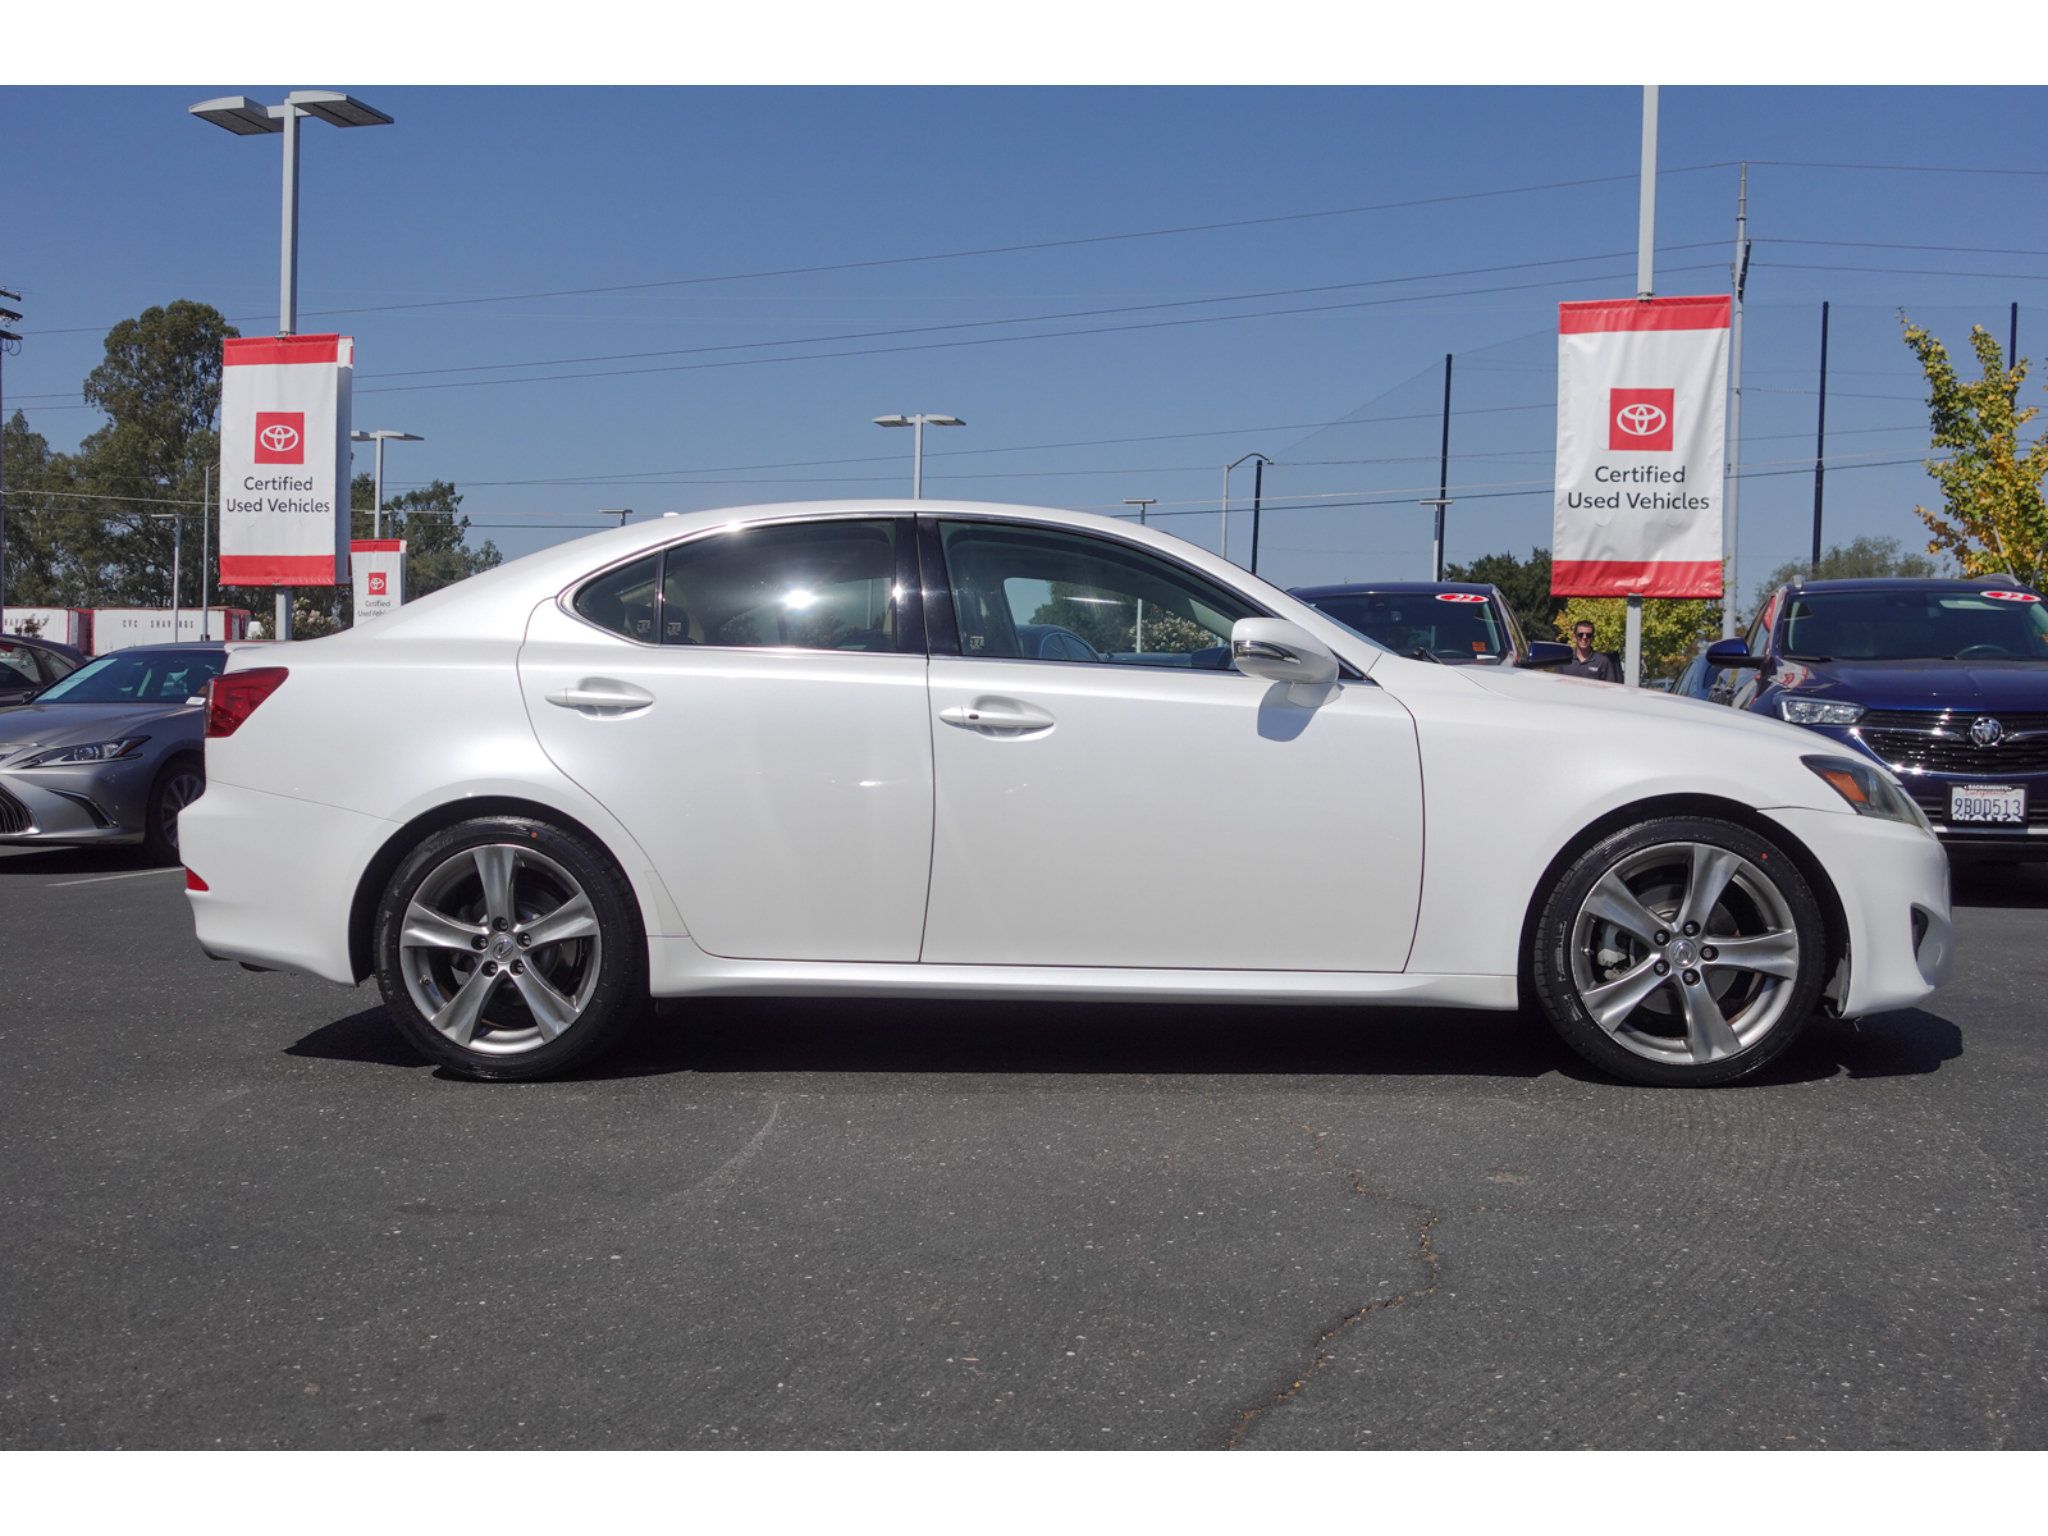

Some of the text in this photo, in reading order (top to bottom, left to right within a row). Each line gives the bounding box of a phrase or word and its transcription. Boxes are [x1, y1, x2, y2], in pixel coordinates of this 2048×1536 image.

[1594, 465, 1686, 483] Certified
[243, 476, 313, 491] Certified
[226, 498, 330, 513] Used Vehicles
[1567, 491, 1710, 510] Used Vehicles
[150, 619, 194, 629] SHAVNGS
